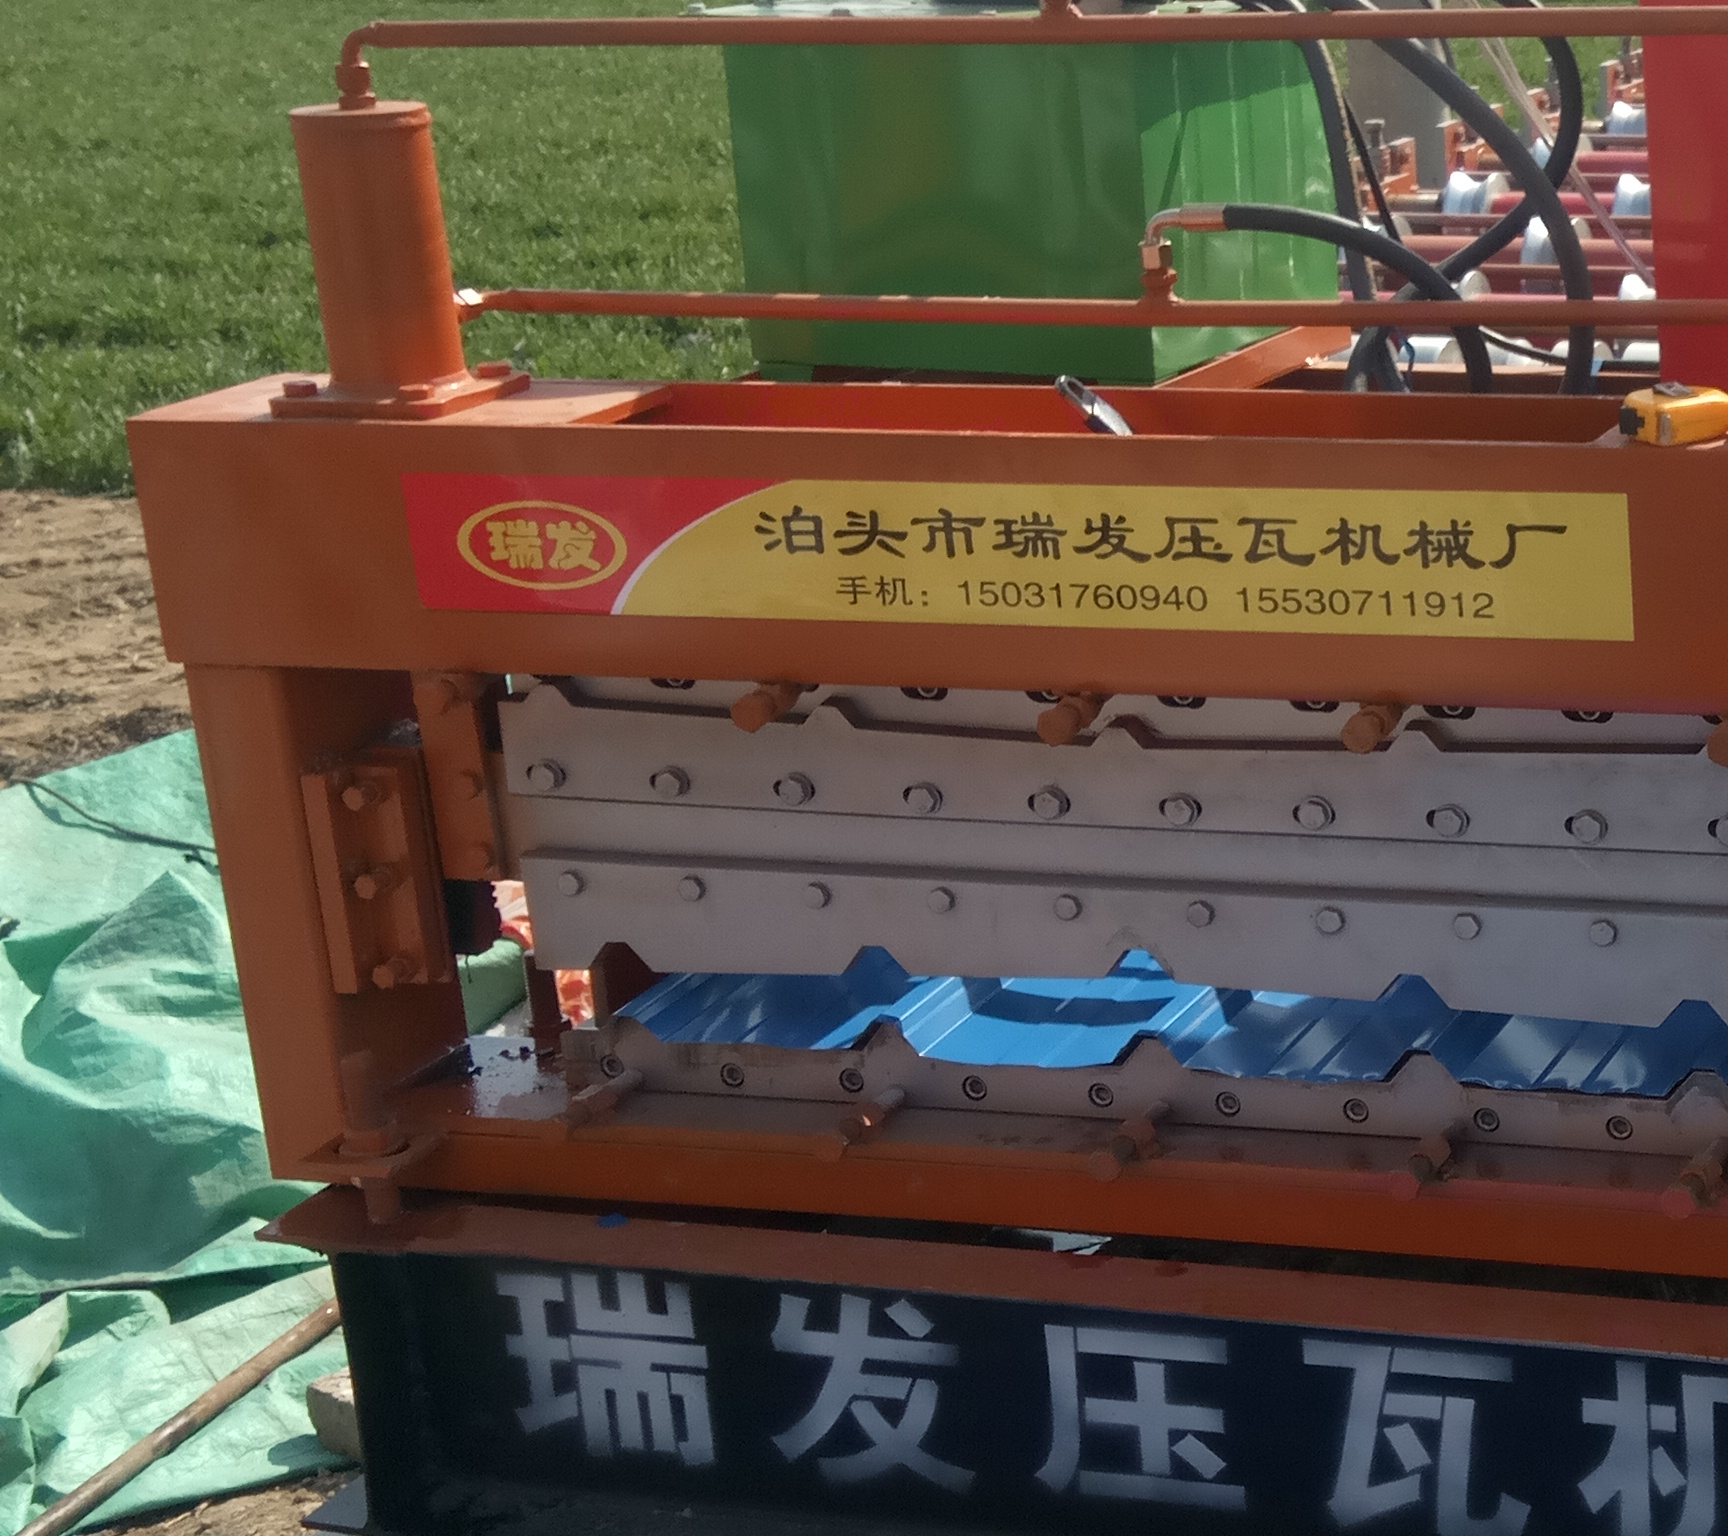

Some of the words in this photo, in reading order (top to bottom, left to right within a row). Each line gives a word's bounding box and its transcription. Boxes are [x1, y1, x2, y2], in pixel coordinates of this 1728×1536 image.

[485, 519, 602, 571] 瑞发
[753, 504, 1568, 570] 泊头市瑞发压瓦机械厂
[956, 580, 1209, 612] 15031760940
[1235, 587, 1496, 620] 15530711912
